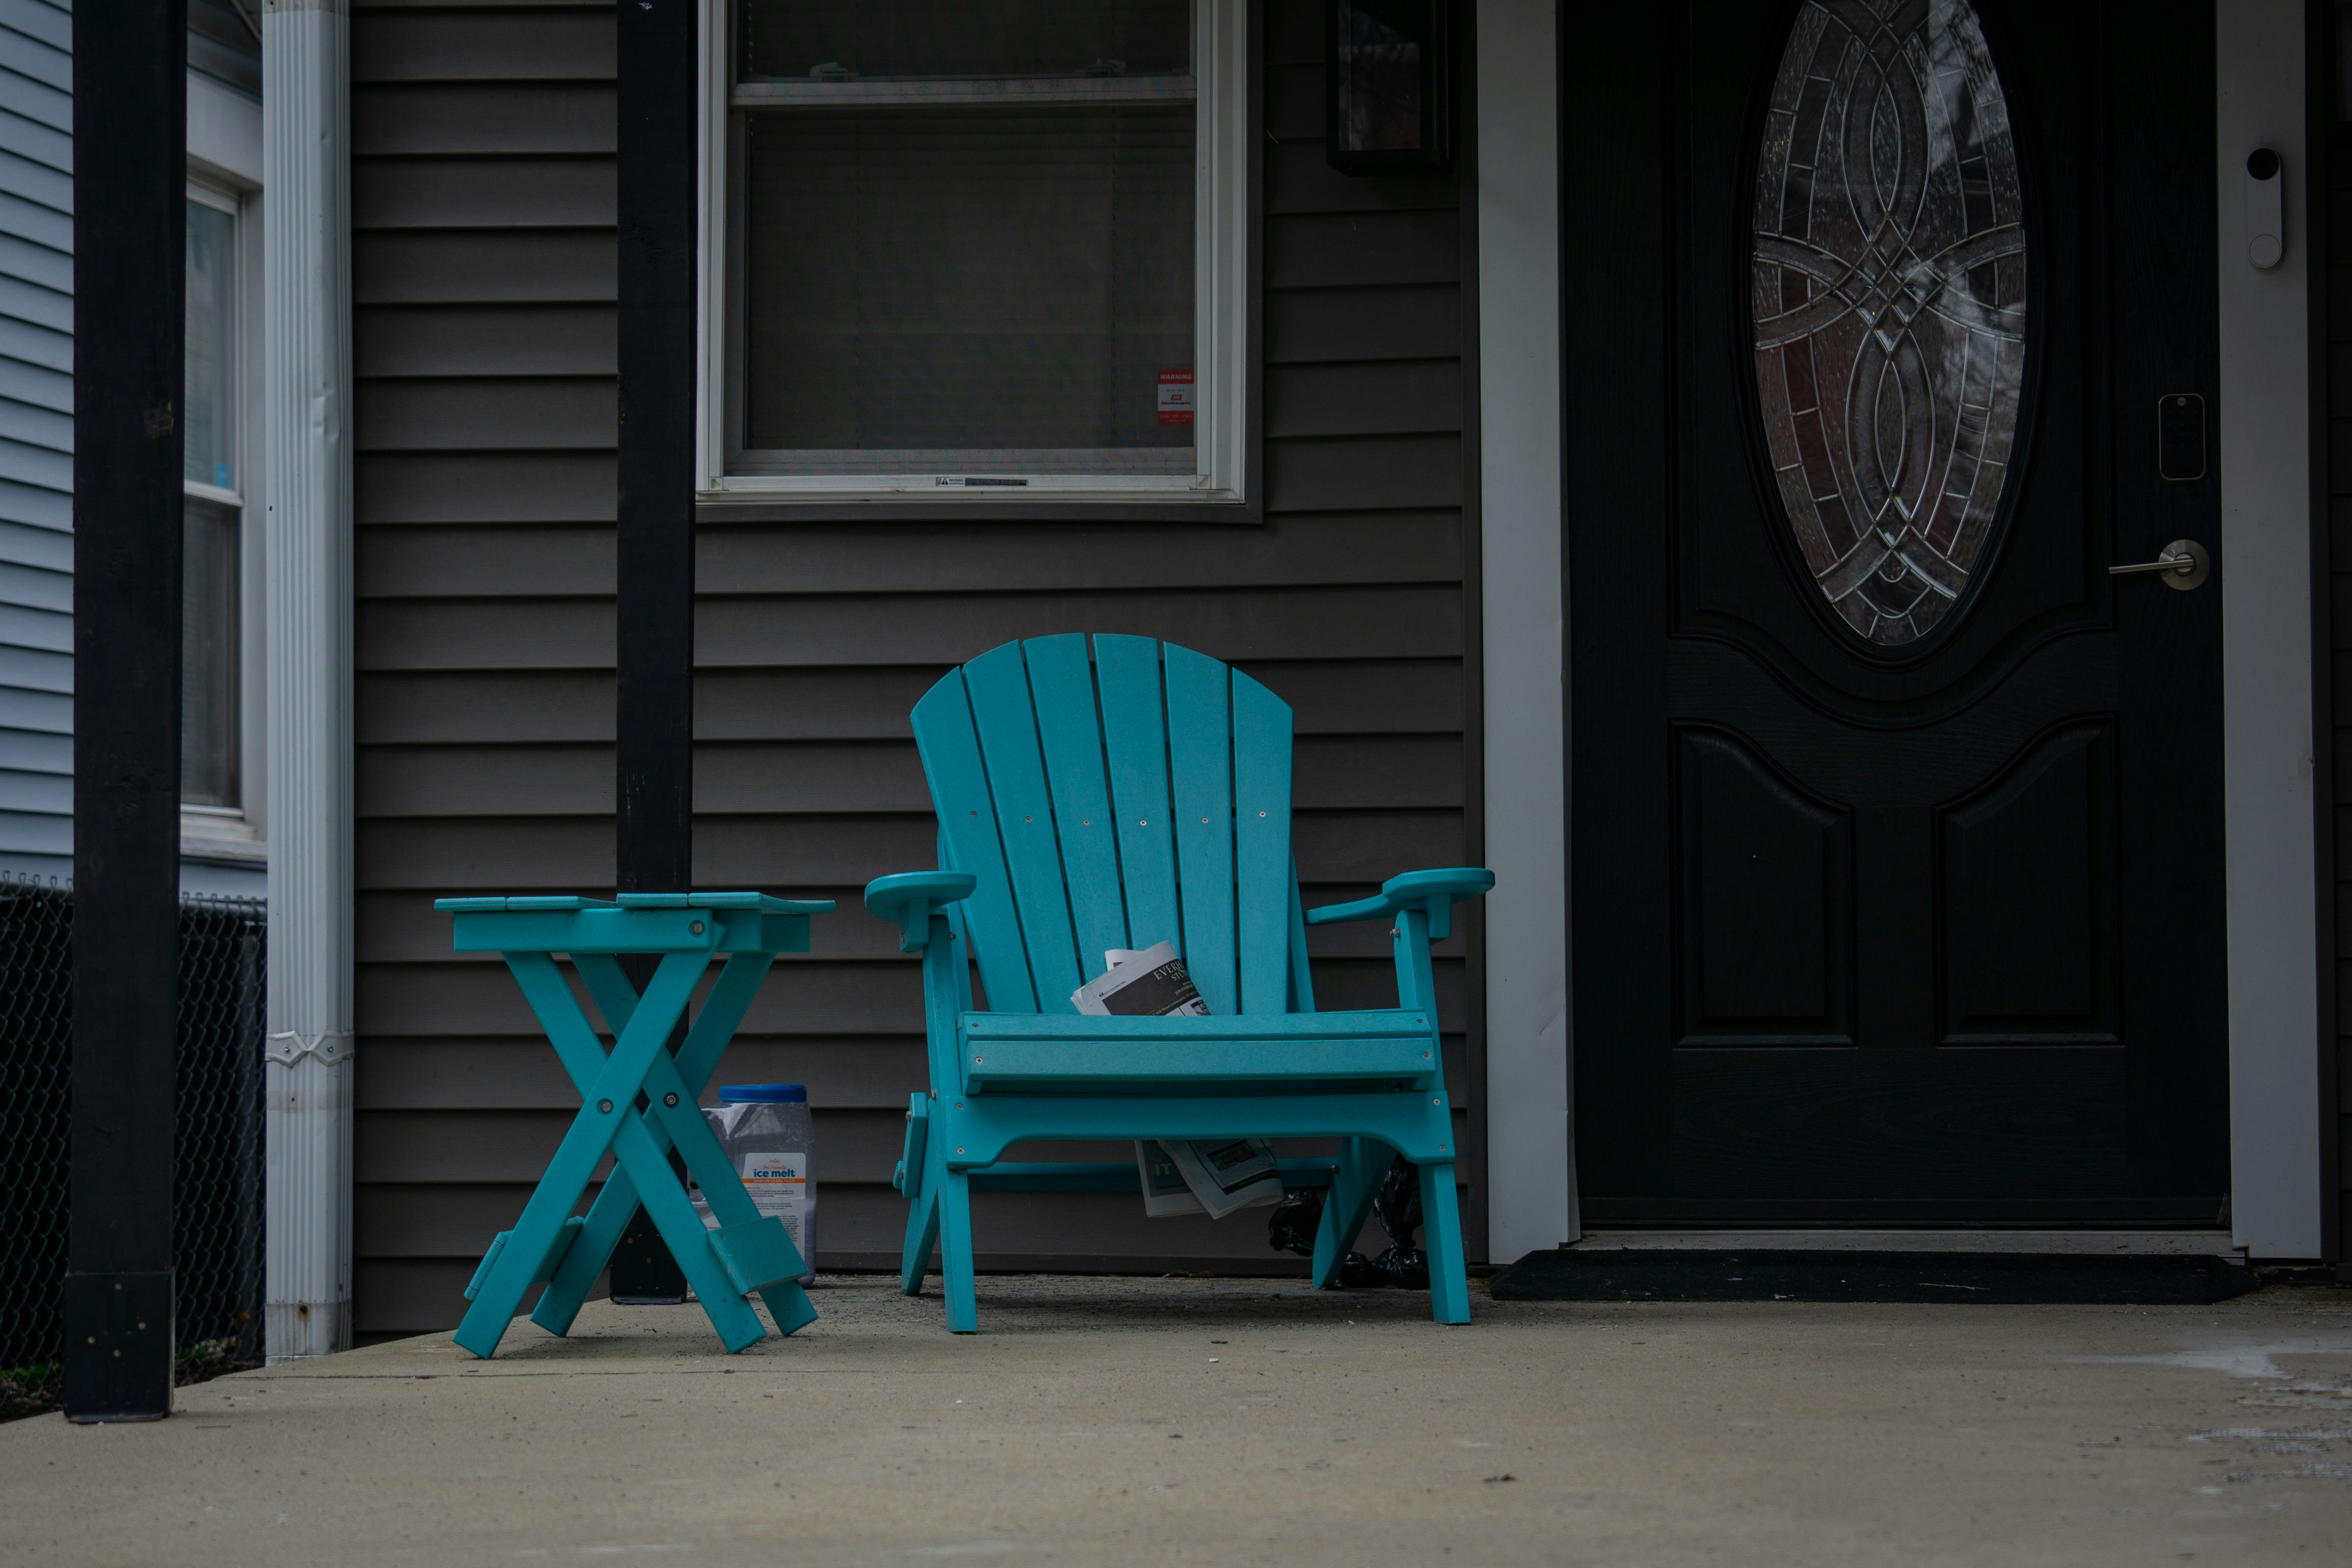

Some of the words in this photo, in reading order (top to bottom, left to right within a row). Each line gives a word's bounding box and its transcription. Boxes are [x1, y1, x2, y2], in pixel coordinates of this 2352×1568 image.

[754, 1169, 769, 1177] ice
[771, 1169, 796, 1177] melt
[1154, 1163, 1171, 1176] IT
